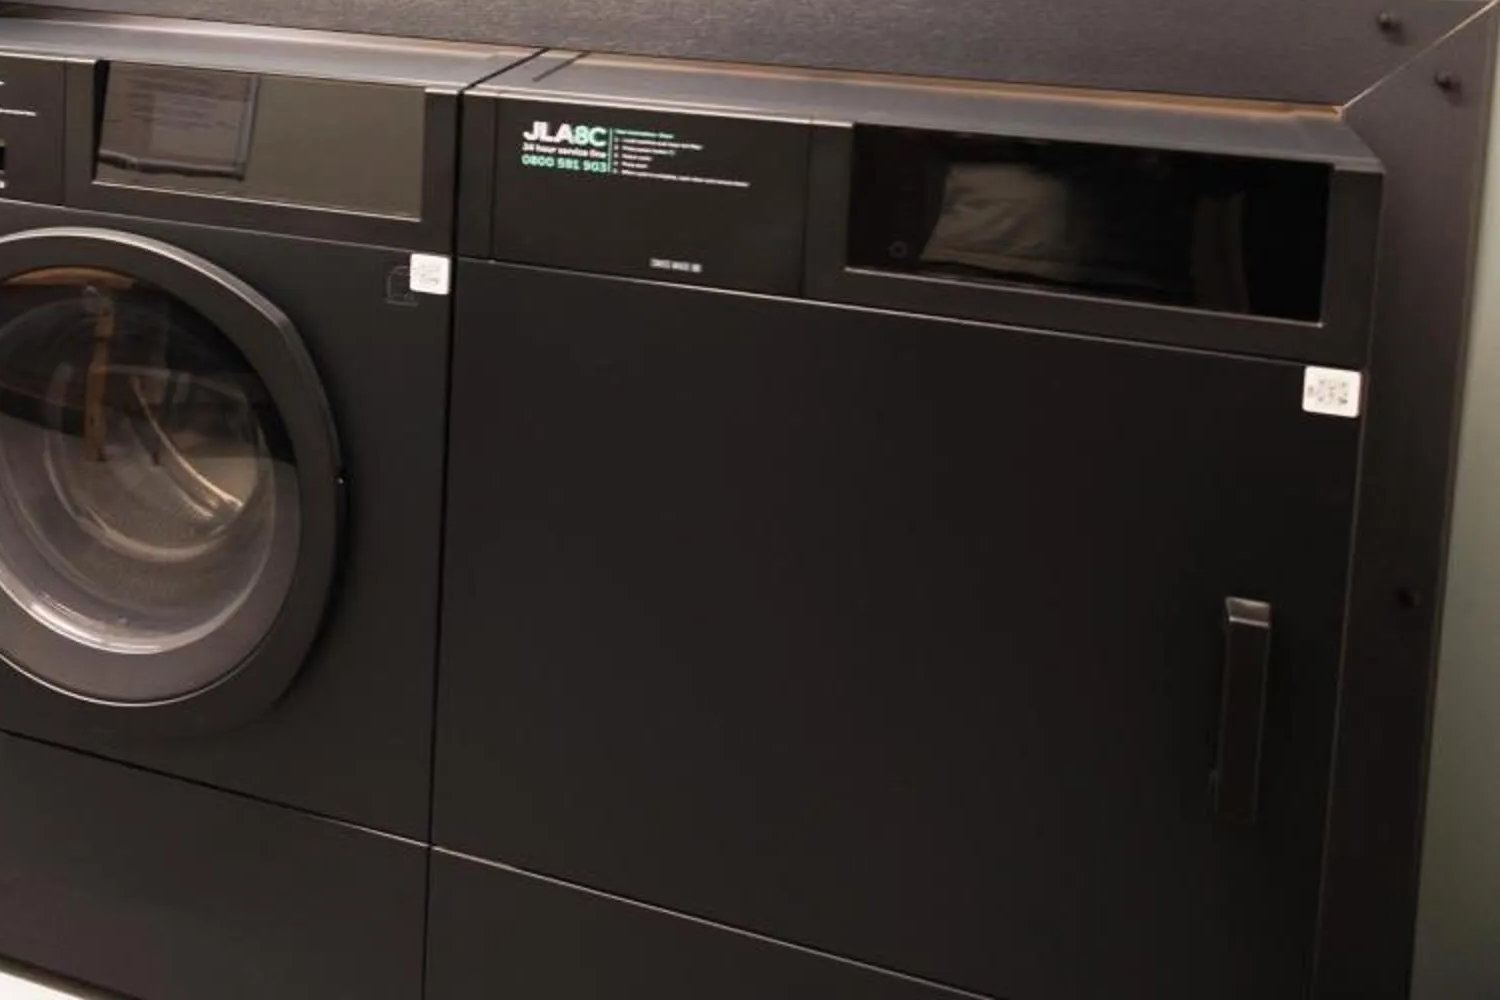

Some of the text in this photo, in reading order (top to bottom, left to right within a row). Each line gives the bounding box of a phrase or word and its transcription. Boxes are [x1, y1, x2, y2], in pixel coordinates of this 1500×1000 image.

[522, 120, 607, 147] JLA8C
[536, 143, 557, 154] hour
[557, 147, 588, 157] service
[589, 149, 607, 158] line
[521, 154, 555, 168] 0800
